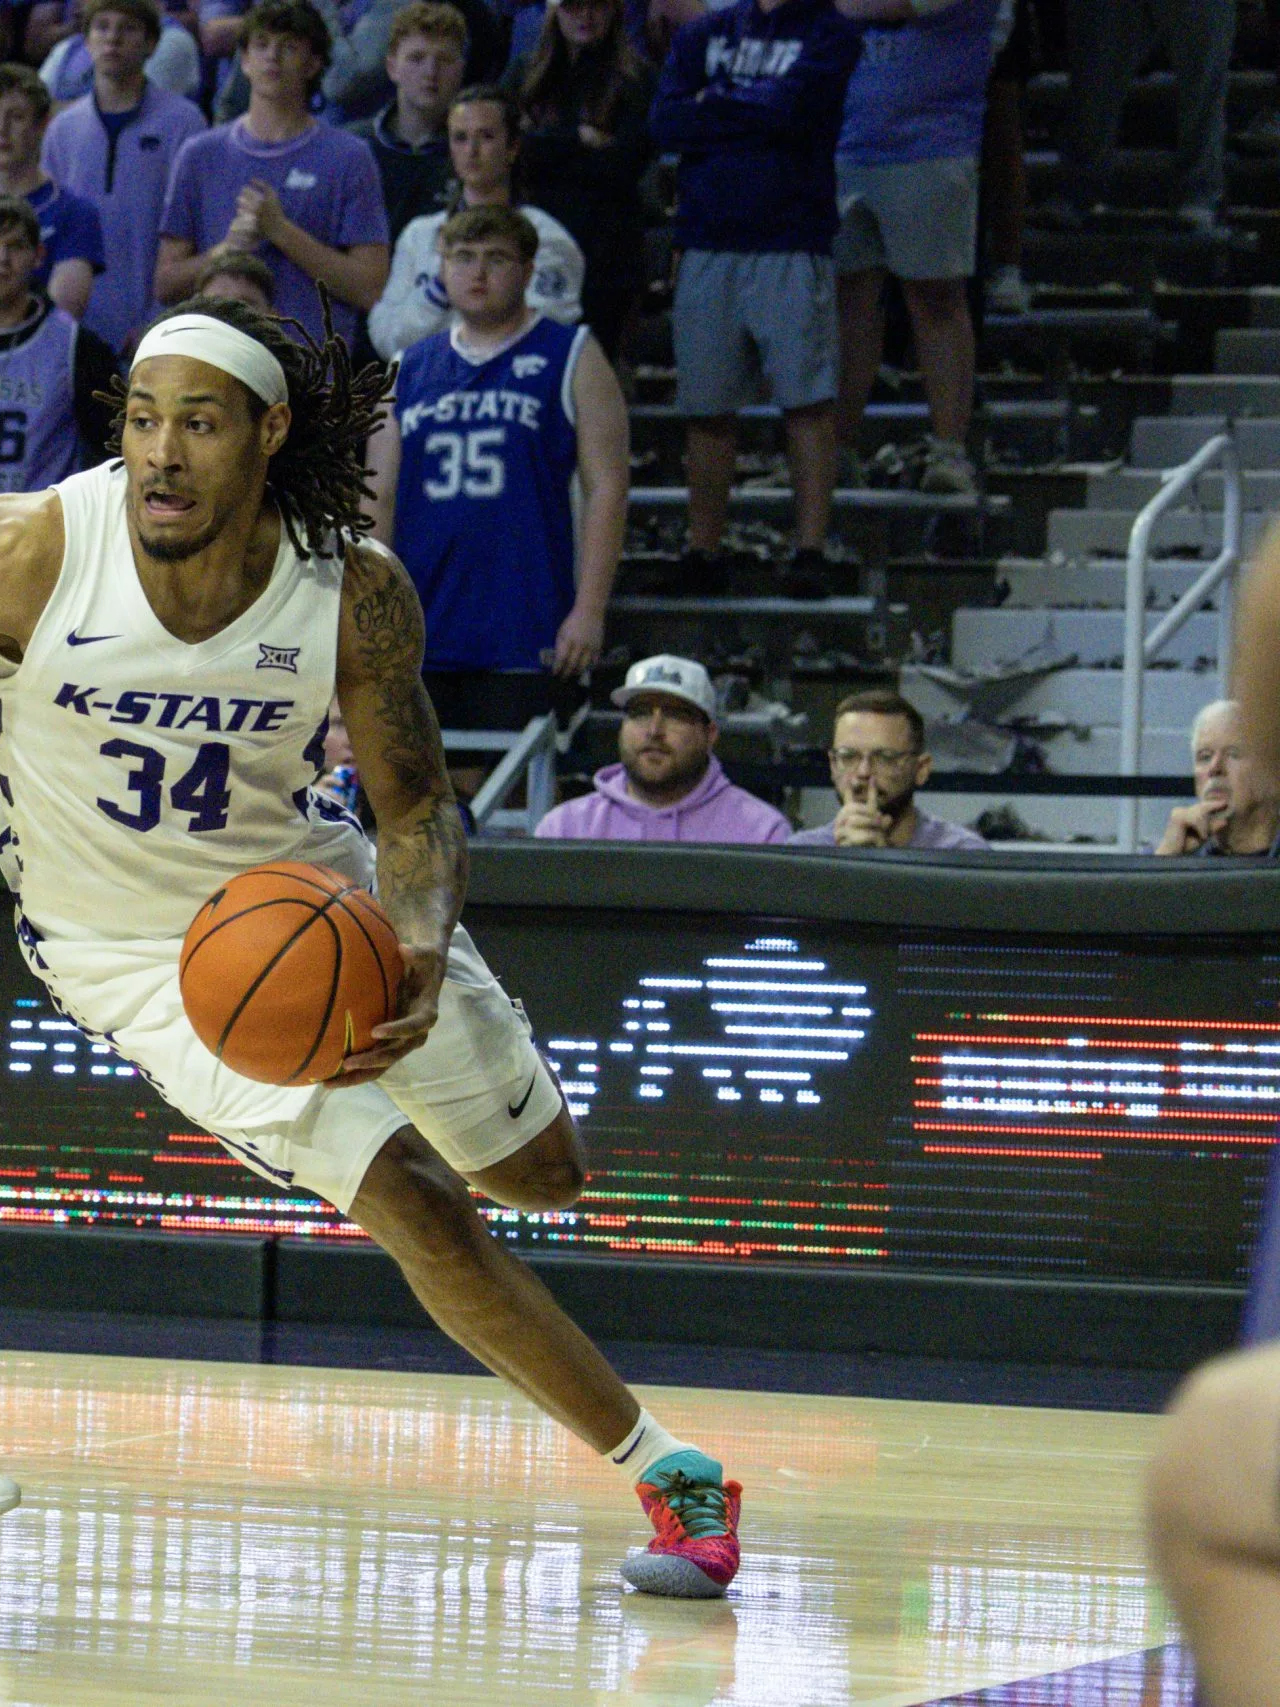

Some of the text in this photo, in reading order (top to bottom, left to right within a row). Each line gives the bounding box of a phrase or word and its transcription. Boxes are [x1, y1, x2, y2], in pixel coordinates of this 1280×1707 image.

[401, 388, 542, 438] K-STATE
[423, 428, 506, 500] 35
[53, 682, 296, 732] K-STATE
[96, 737, 232, 833] 34
